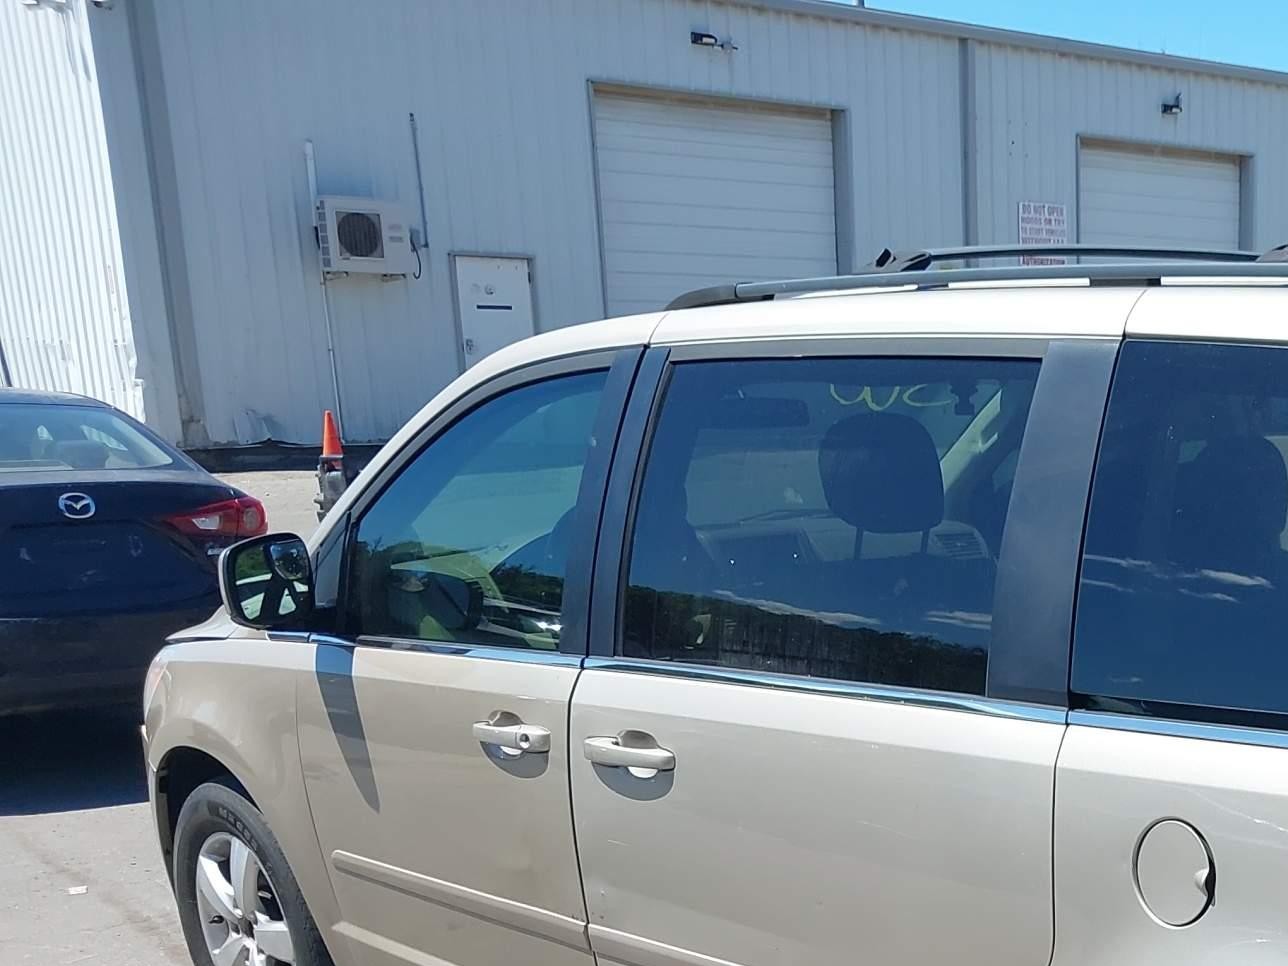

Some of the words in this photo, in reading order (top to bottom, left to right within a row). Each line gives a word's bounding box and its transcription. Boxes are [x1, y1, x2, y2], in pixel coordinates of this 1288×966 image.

[1022, 203, 1031, 215] DO
[1033, 204, 1045, 217] NOT
[1047, 206, 1064, 217] OPEN
[1044, 217, 1052, 226] OR
